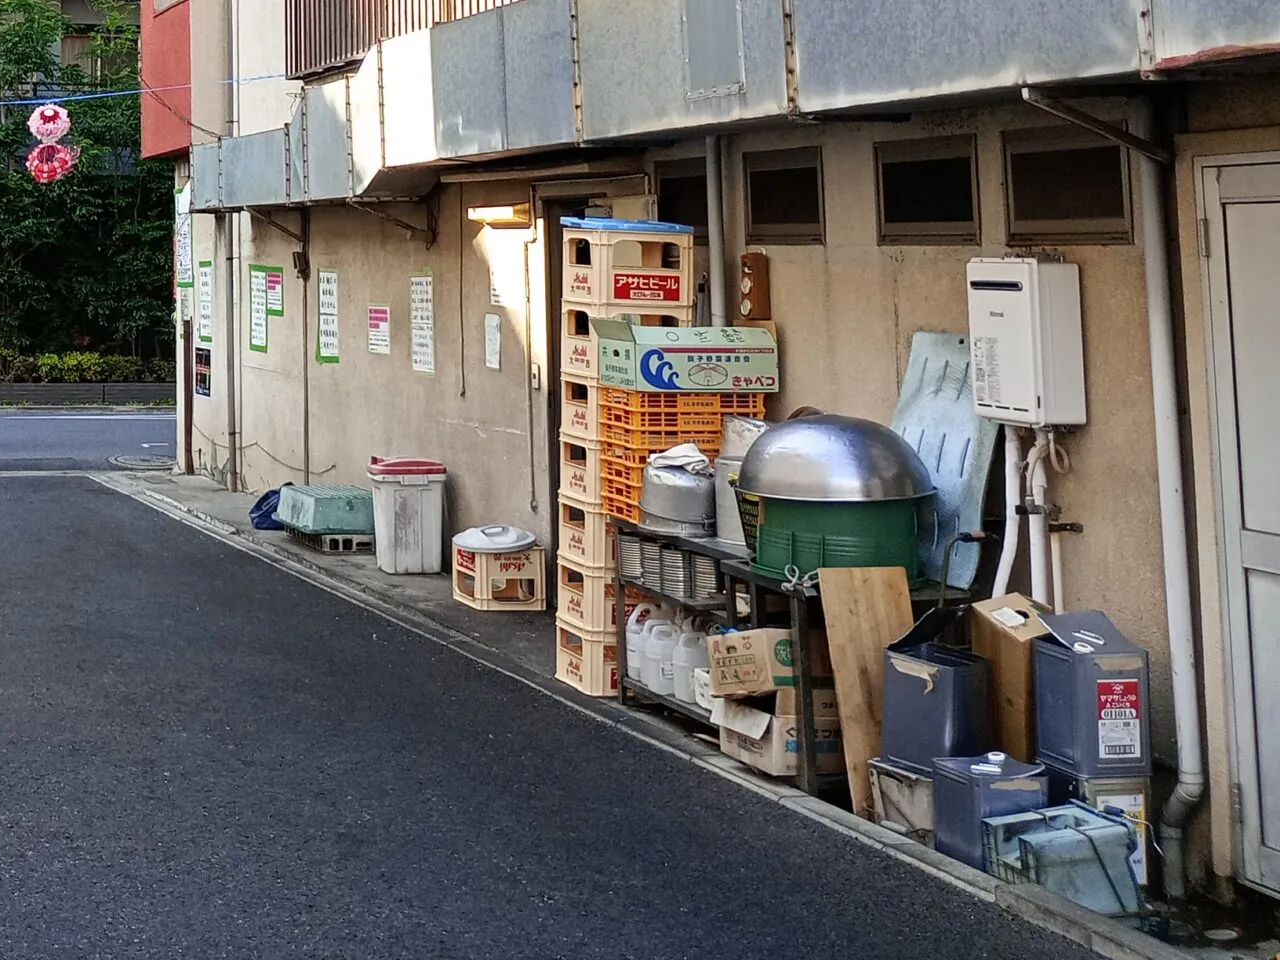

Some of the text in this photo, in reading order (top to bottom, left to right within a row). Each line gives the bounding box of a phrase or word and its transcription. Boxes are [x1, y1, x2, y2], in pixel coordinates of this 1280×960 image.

[616, 276, 678, 289] アサヒビール
